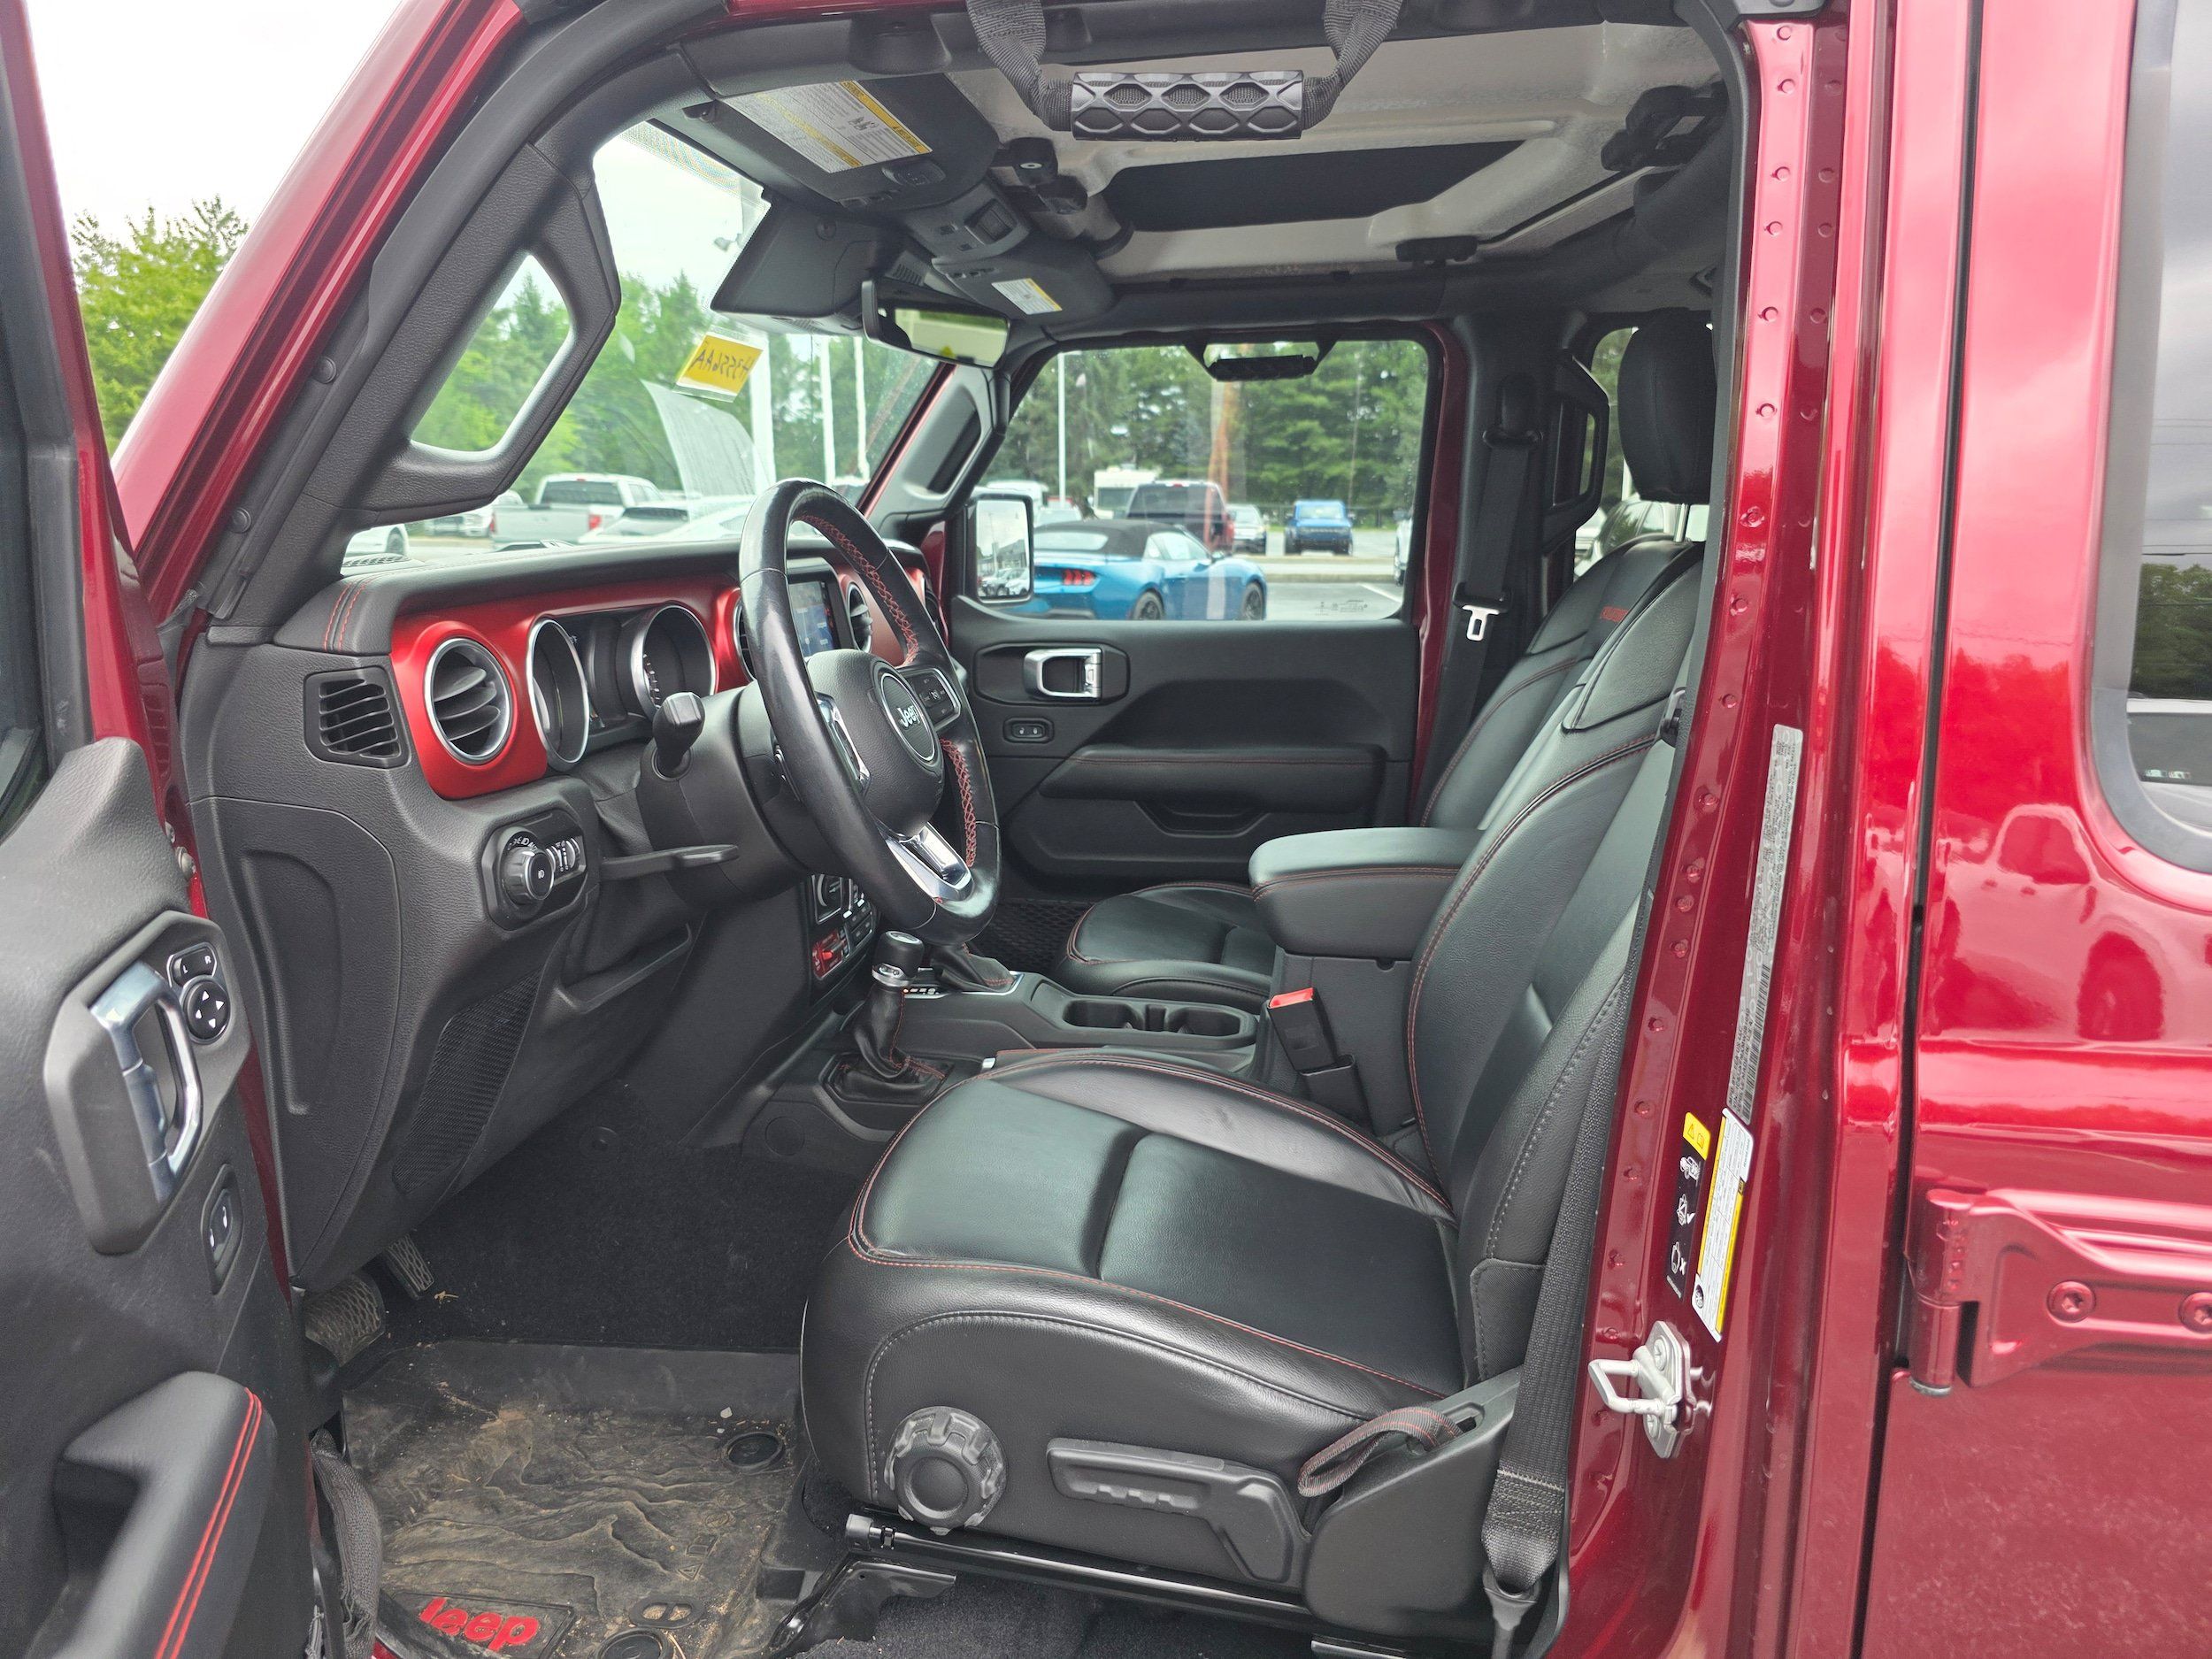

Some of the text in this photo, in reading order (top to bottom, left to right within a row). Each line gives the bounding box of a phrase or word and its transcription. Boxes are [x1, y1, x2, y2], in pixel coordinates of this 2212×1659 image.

[897, 704, 920, 727] Jeep
[204, 956, 211, 964] R
[182, 965, 188, 974] L
